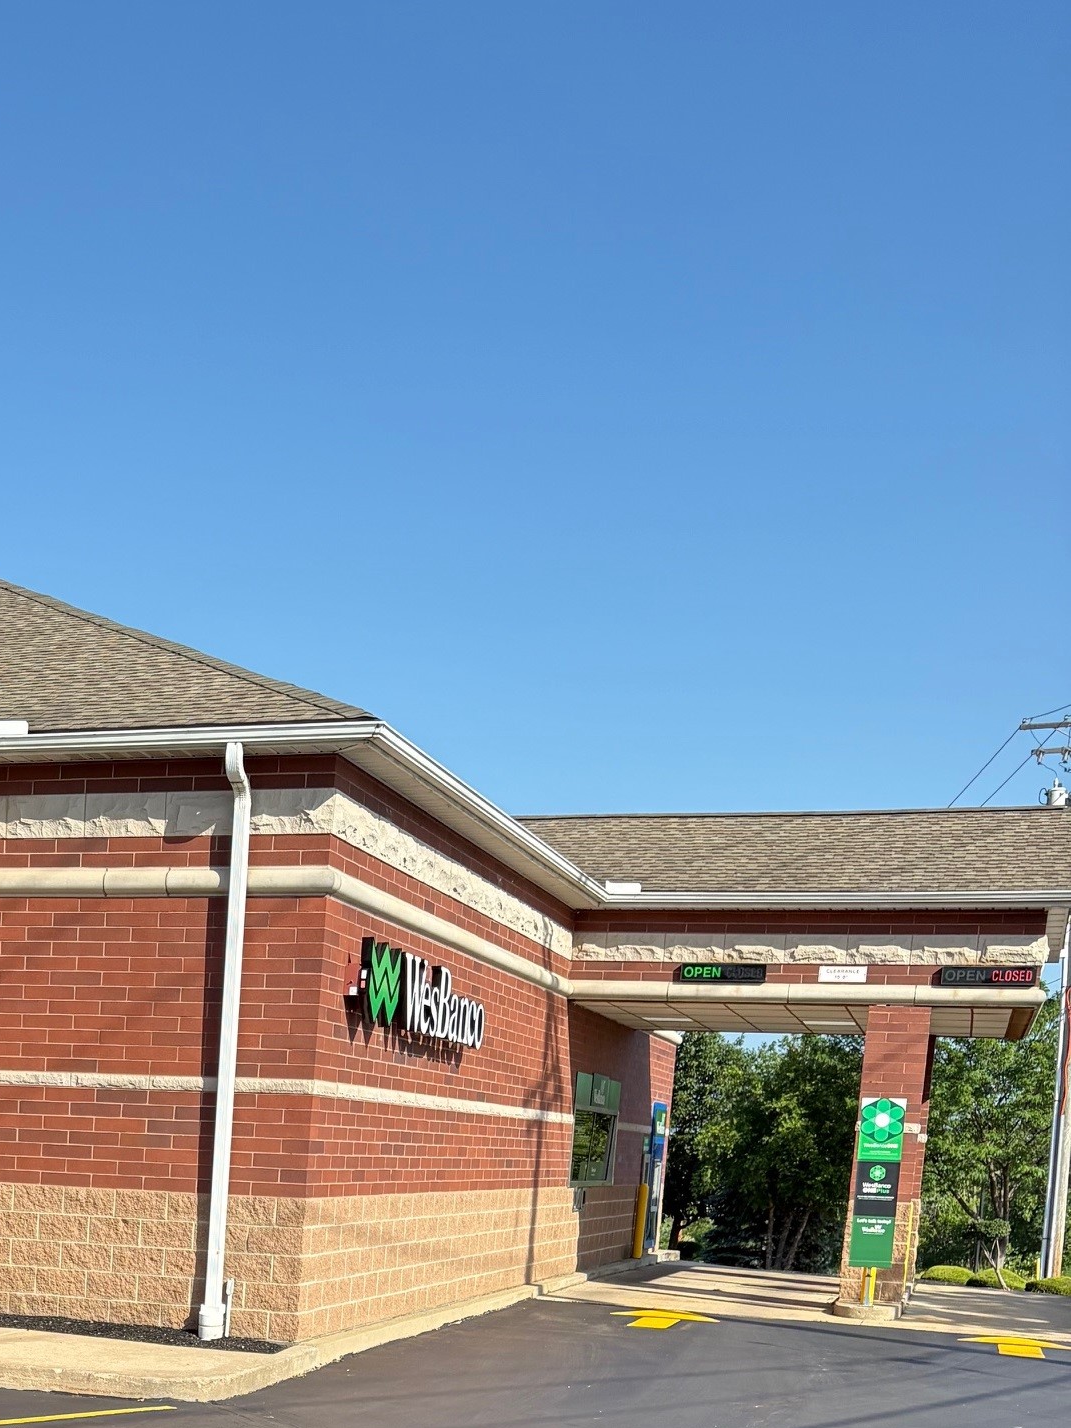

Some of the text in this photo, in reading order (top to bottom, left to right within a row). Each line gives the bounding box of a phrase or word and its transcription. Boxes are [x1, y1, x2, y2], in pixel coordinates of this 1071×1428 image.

[683, 966, 722, 978] OPEN
[945, 969, 1033, 982] OPEN CLOSED
[405, 952, 485, 1050] WesBanco
